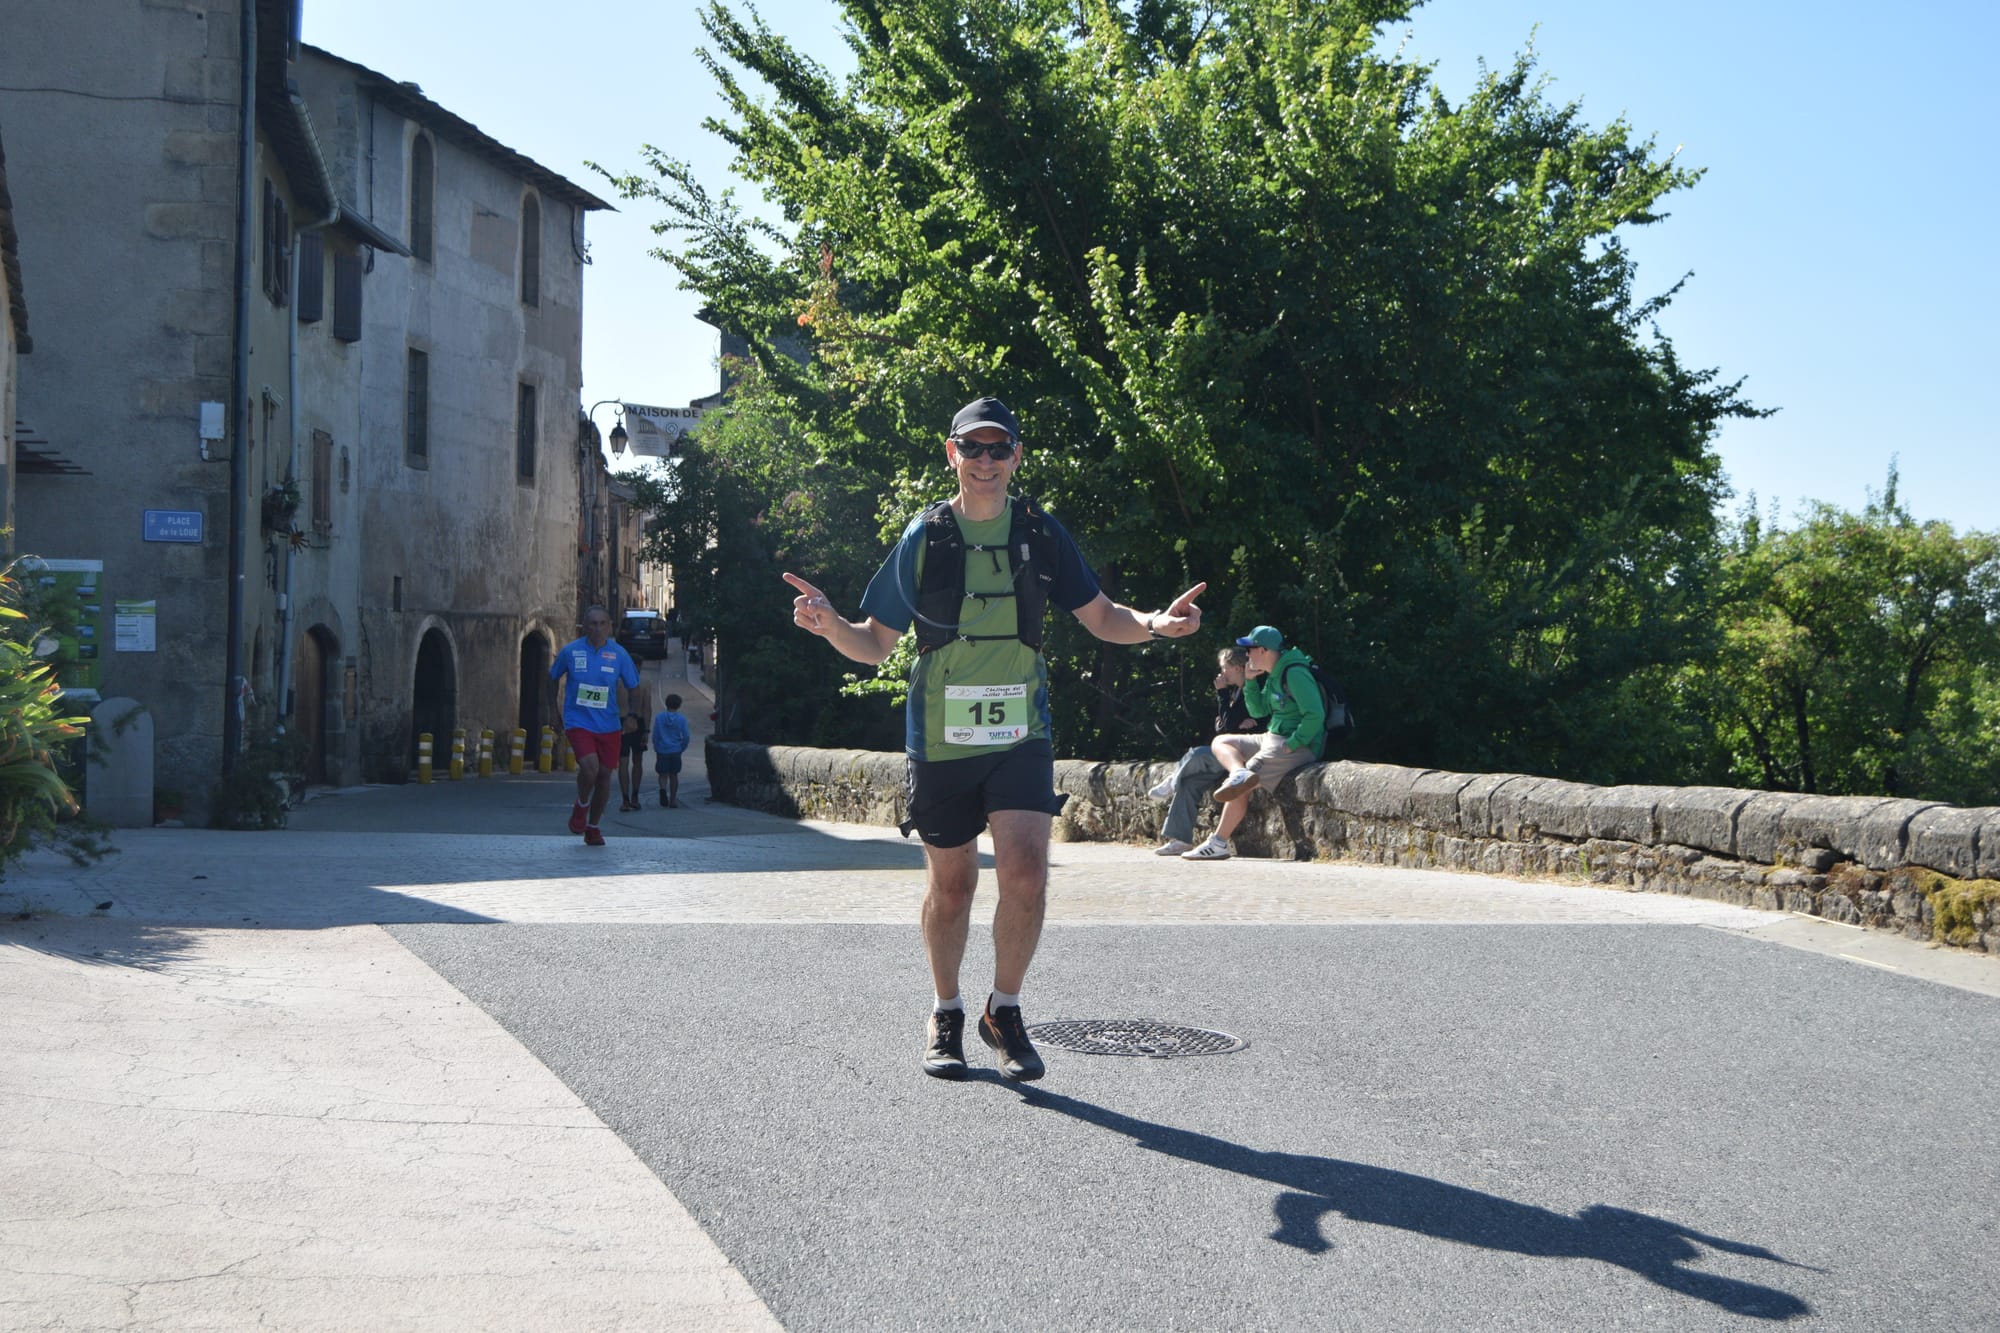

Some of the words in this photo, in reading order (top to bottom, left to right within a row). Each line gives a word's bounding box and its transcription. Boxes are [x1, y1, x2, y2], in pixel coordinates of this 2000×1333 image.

[628, 406, 679, 418] MAISON
[683, 408, 699, 418] DE
[167, 516, 191, 526] PLACE
[586, 690, 601, 701] 78
[968, 701, 1005, 725] 15
